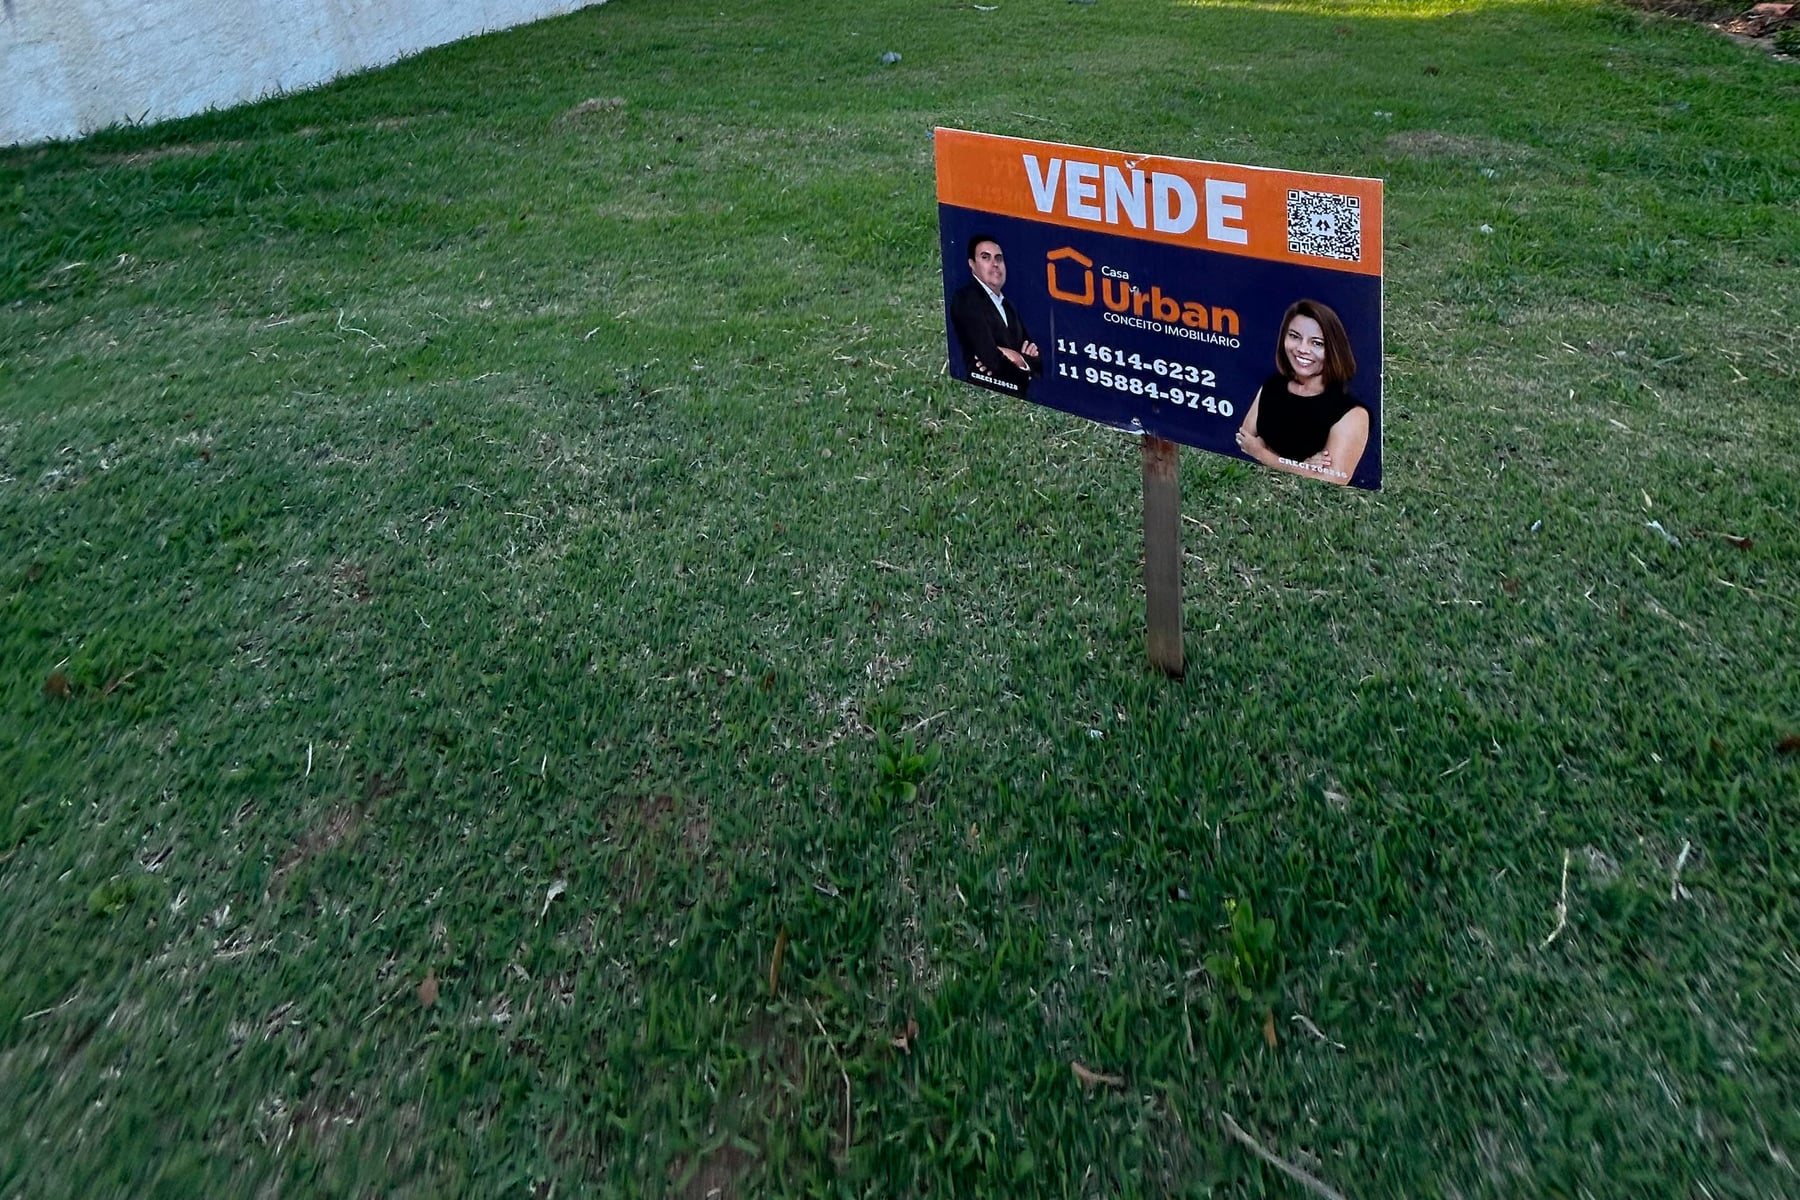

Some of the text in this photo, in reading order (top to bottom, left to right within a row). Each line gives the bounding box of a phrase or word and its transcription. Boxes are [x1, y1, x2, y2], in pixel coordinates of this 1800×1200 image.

[1023, 155, 1248, 245] VENDE
[1101, 265, 1130, 280] Casa
[1102, 277, 1240, 336] Urban
[1103, 312, 1240, 349] CONCEITO IMOBILIÁRIO
[1057, 338, 1216, 388] 11 4614-6232
[1058, 363, 1234, 417] 11 95884-9740
[1278, 457, 1310, 470] CRECI
